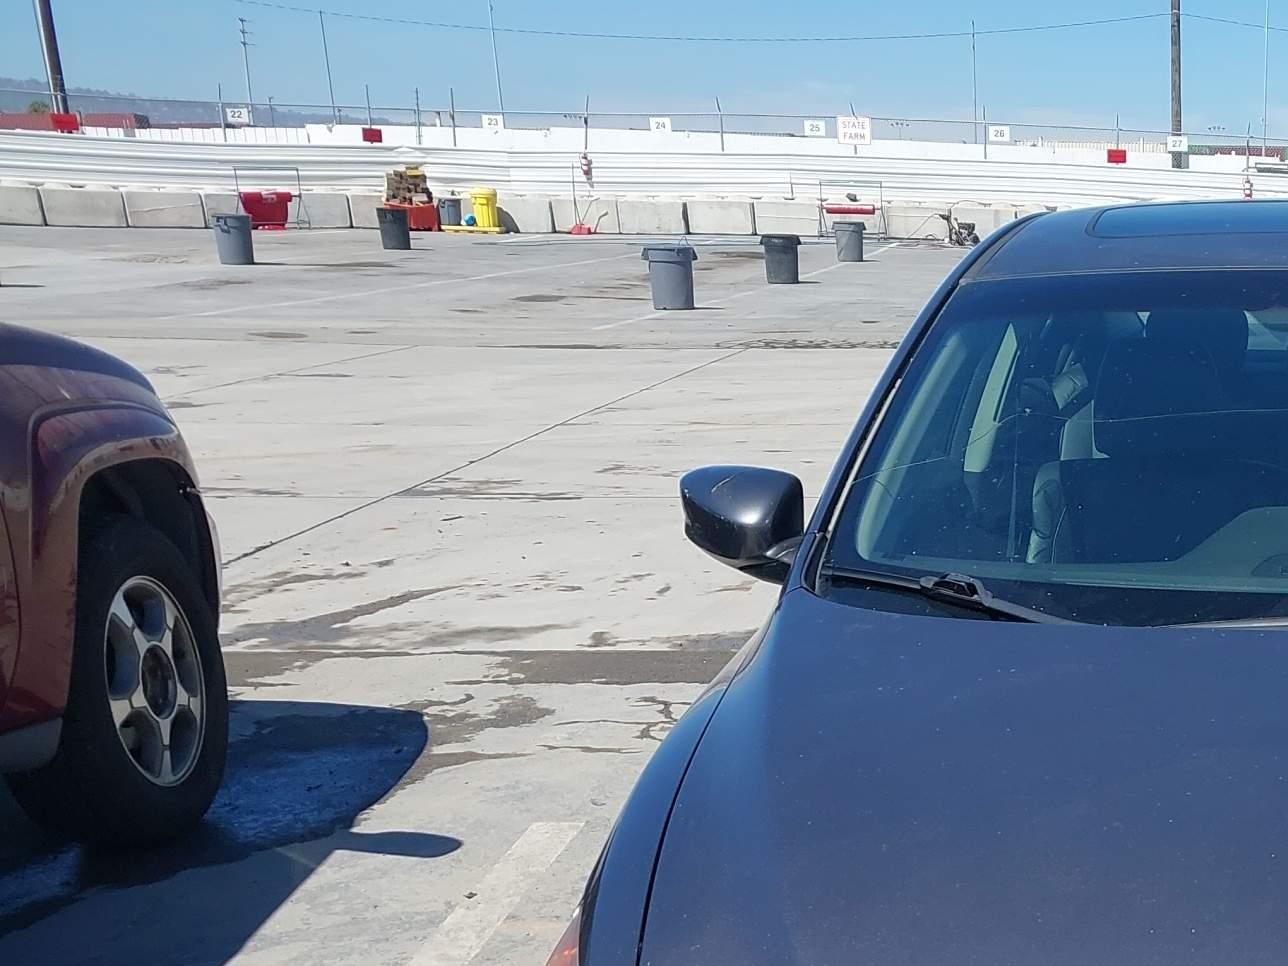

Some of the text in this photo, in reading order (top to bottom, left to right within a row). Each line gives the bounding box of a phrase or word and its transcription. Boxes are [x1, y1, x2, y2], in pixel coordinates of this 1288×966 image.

[229, 109, 243, 119] 22
[487, 117, 499, 126] 23
[655, 121, 667, 130] 24
[841, 120, 867, 130] STATE
[809, 123, 821, 132] 25
[843, 132, 867, 142] FARM
[993, 128, 1006, 139] 26
[1171, 138, 1183, 149] 27
